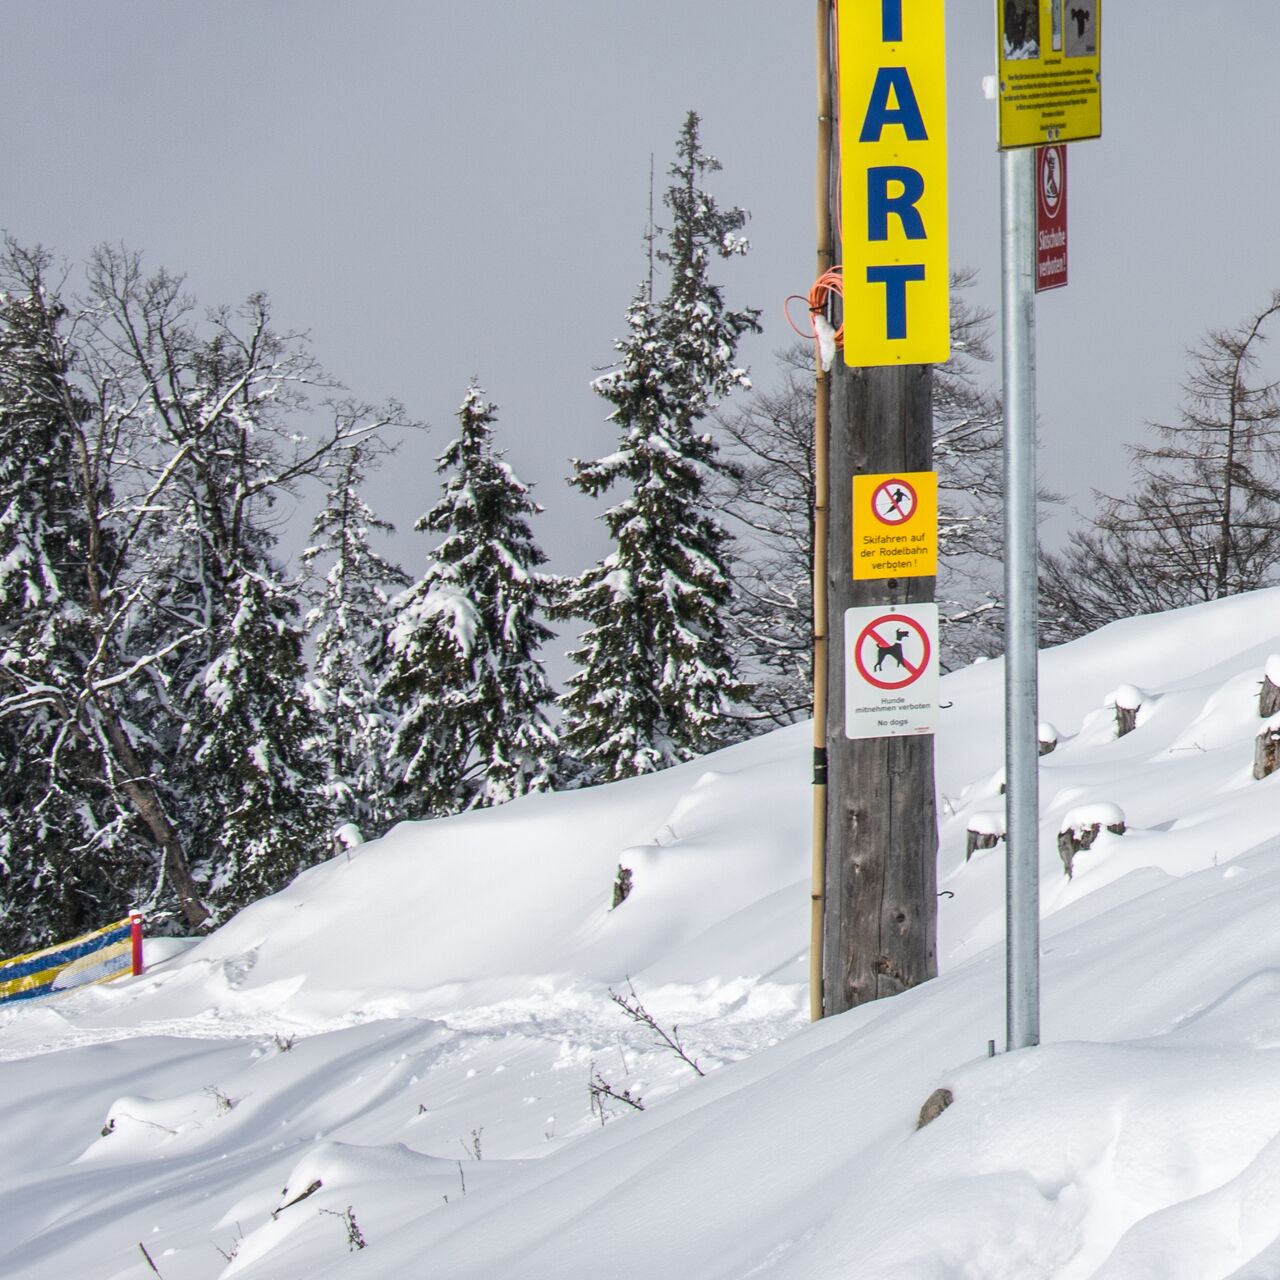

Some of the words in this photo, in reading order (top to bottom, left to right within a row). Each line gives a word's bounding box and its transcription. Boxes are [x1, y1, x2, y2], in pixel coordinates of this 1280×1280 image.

[863, 535, 907, 545] Skifahren
[910, 533, 926, 542] auf
[860, 549, 876, 558] der
[879, 546, 928, 557] Rodelbahn
[872, 560, 912, 570] verboten
[881, 696, 906, 705] Hunde
[855, 704, 897, 714] mitnehmen
[898, 702, 931, 711] verboten
[889, 718, 909, 727] dogs
